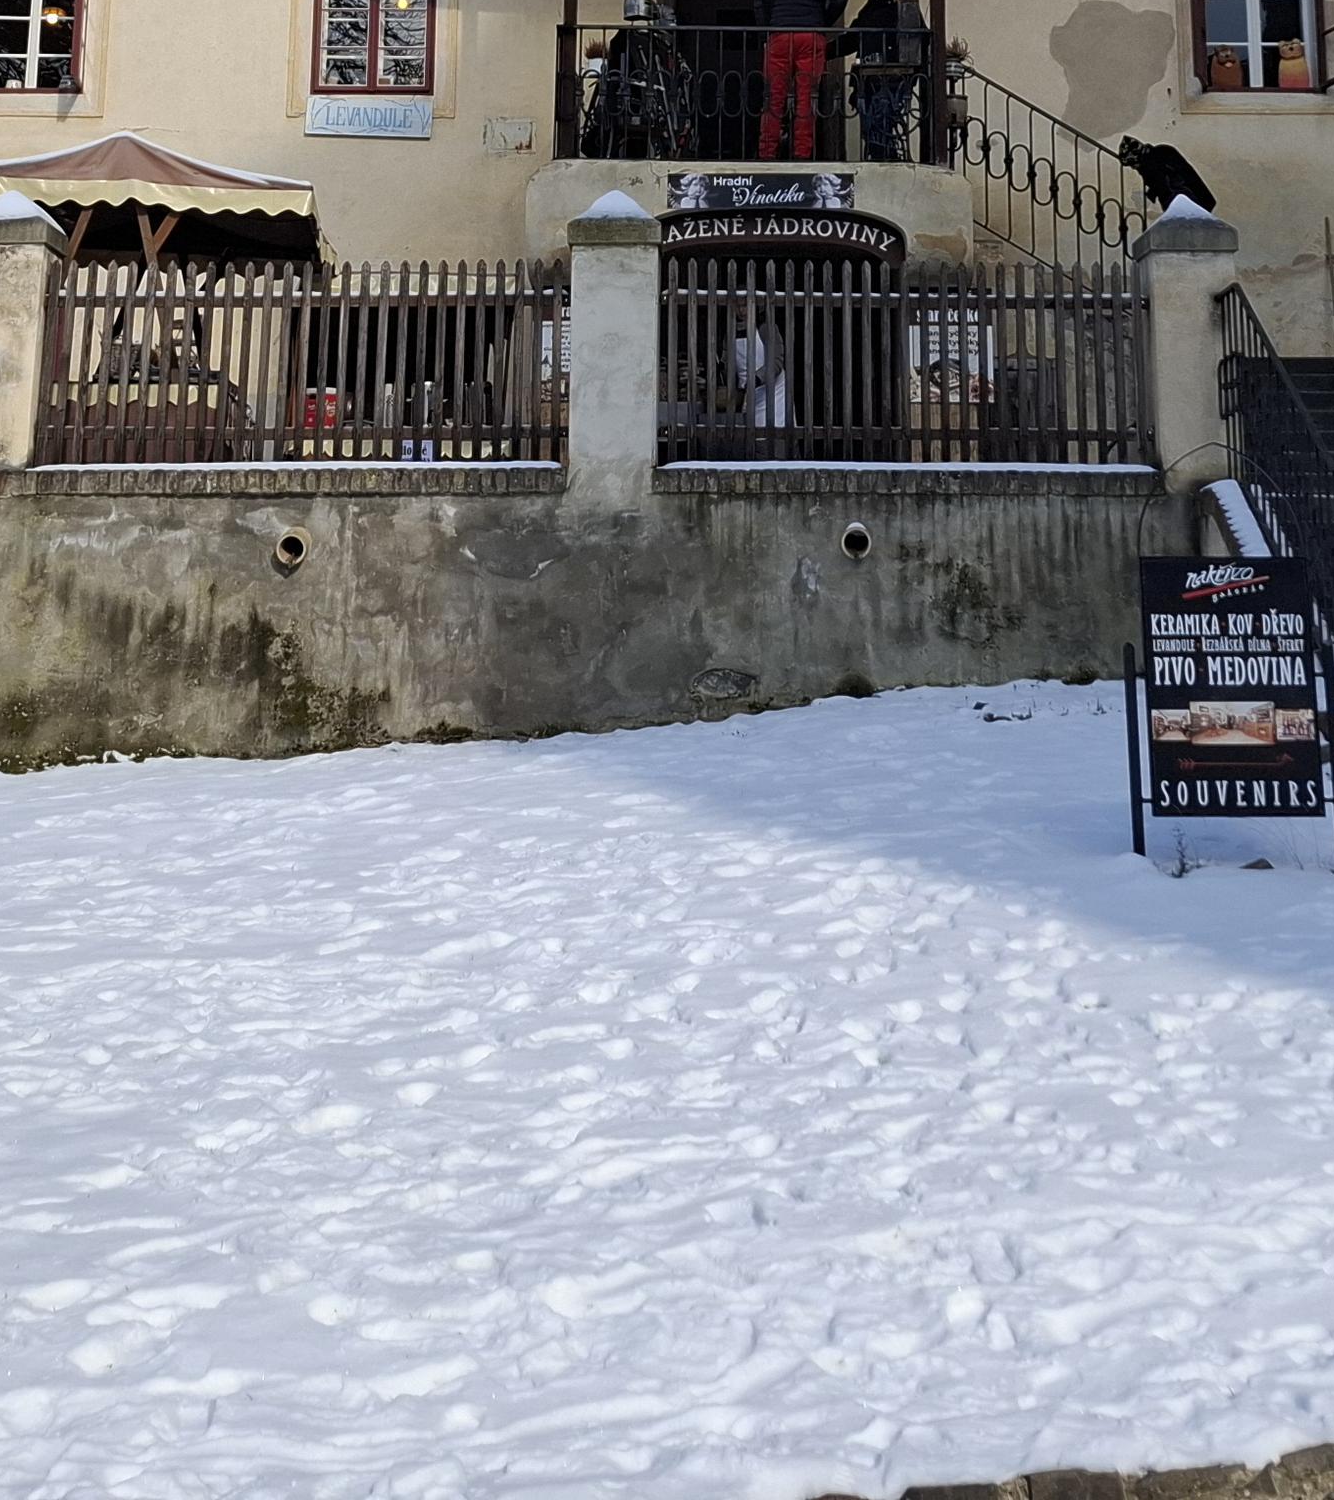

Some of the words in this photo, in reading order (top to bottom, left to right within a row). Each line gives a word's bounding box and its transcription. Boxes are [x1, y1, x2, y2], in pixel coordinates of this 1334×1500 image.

[325, 105, 413, 128] LEVANDULE
[713, 175, 753, 187] Hradní
[734, 182, 805, 206] Vinotéka
[663, 213, 746, 244] AŽENÉ
[753, 213, 897, 251] JÁDROVINY
[1150, 613, 1221, 636] KERAMIKA
[1227, 613, 1254, 636] KOV
[1262, 608, 1304, 636] DŘEVO
[1152, 638, 1196, 652] LEVANDULE
[1153, 655, 1196, 686] PIVO
[1206, 655, 1308, 686] MEDOVINA
[1160, 779, 1317, 807] SOUVENIRS
